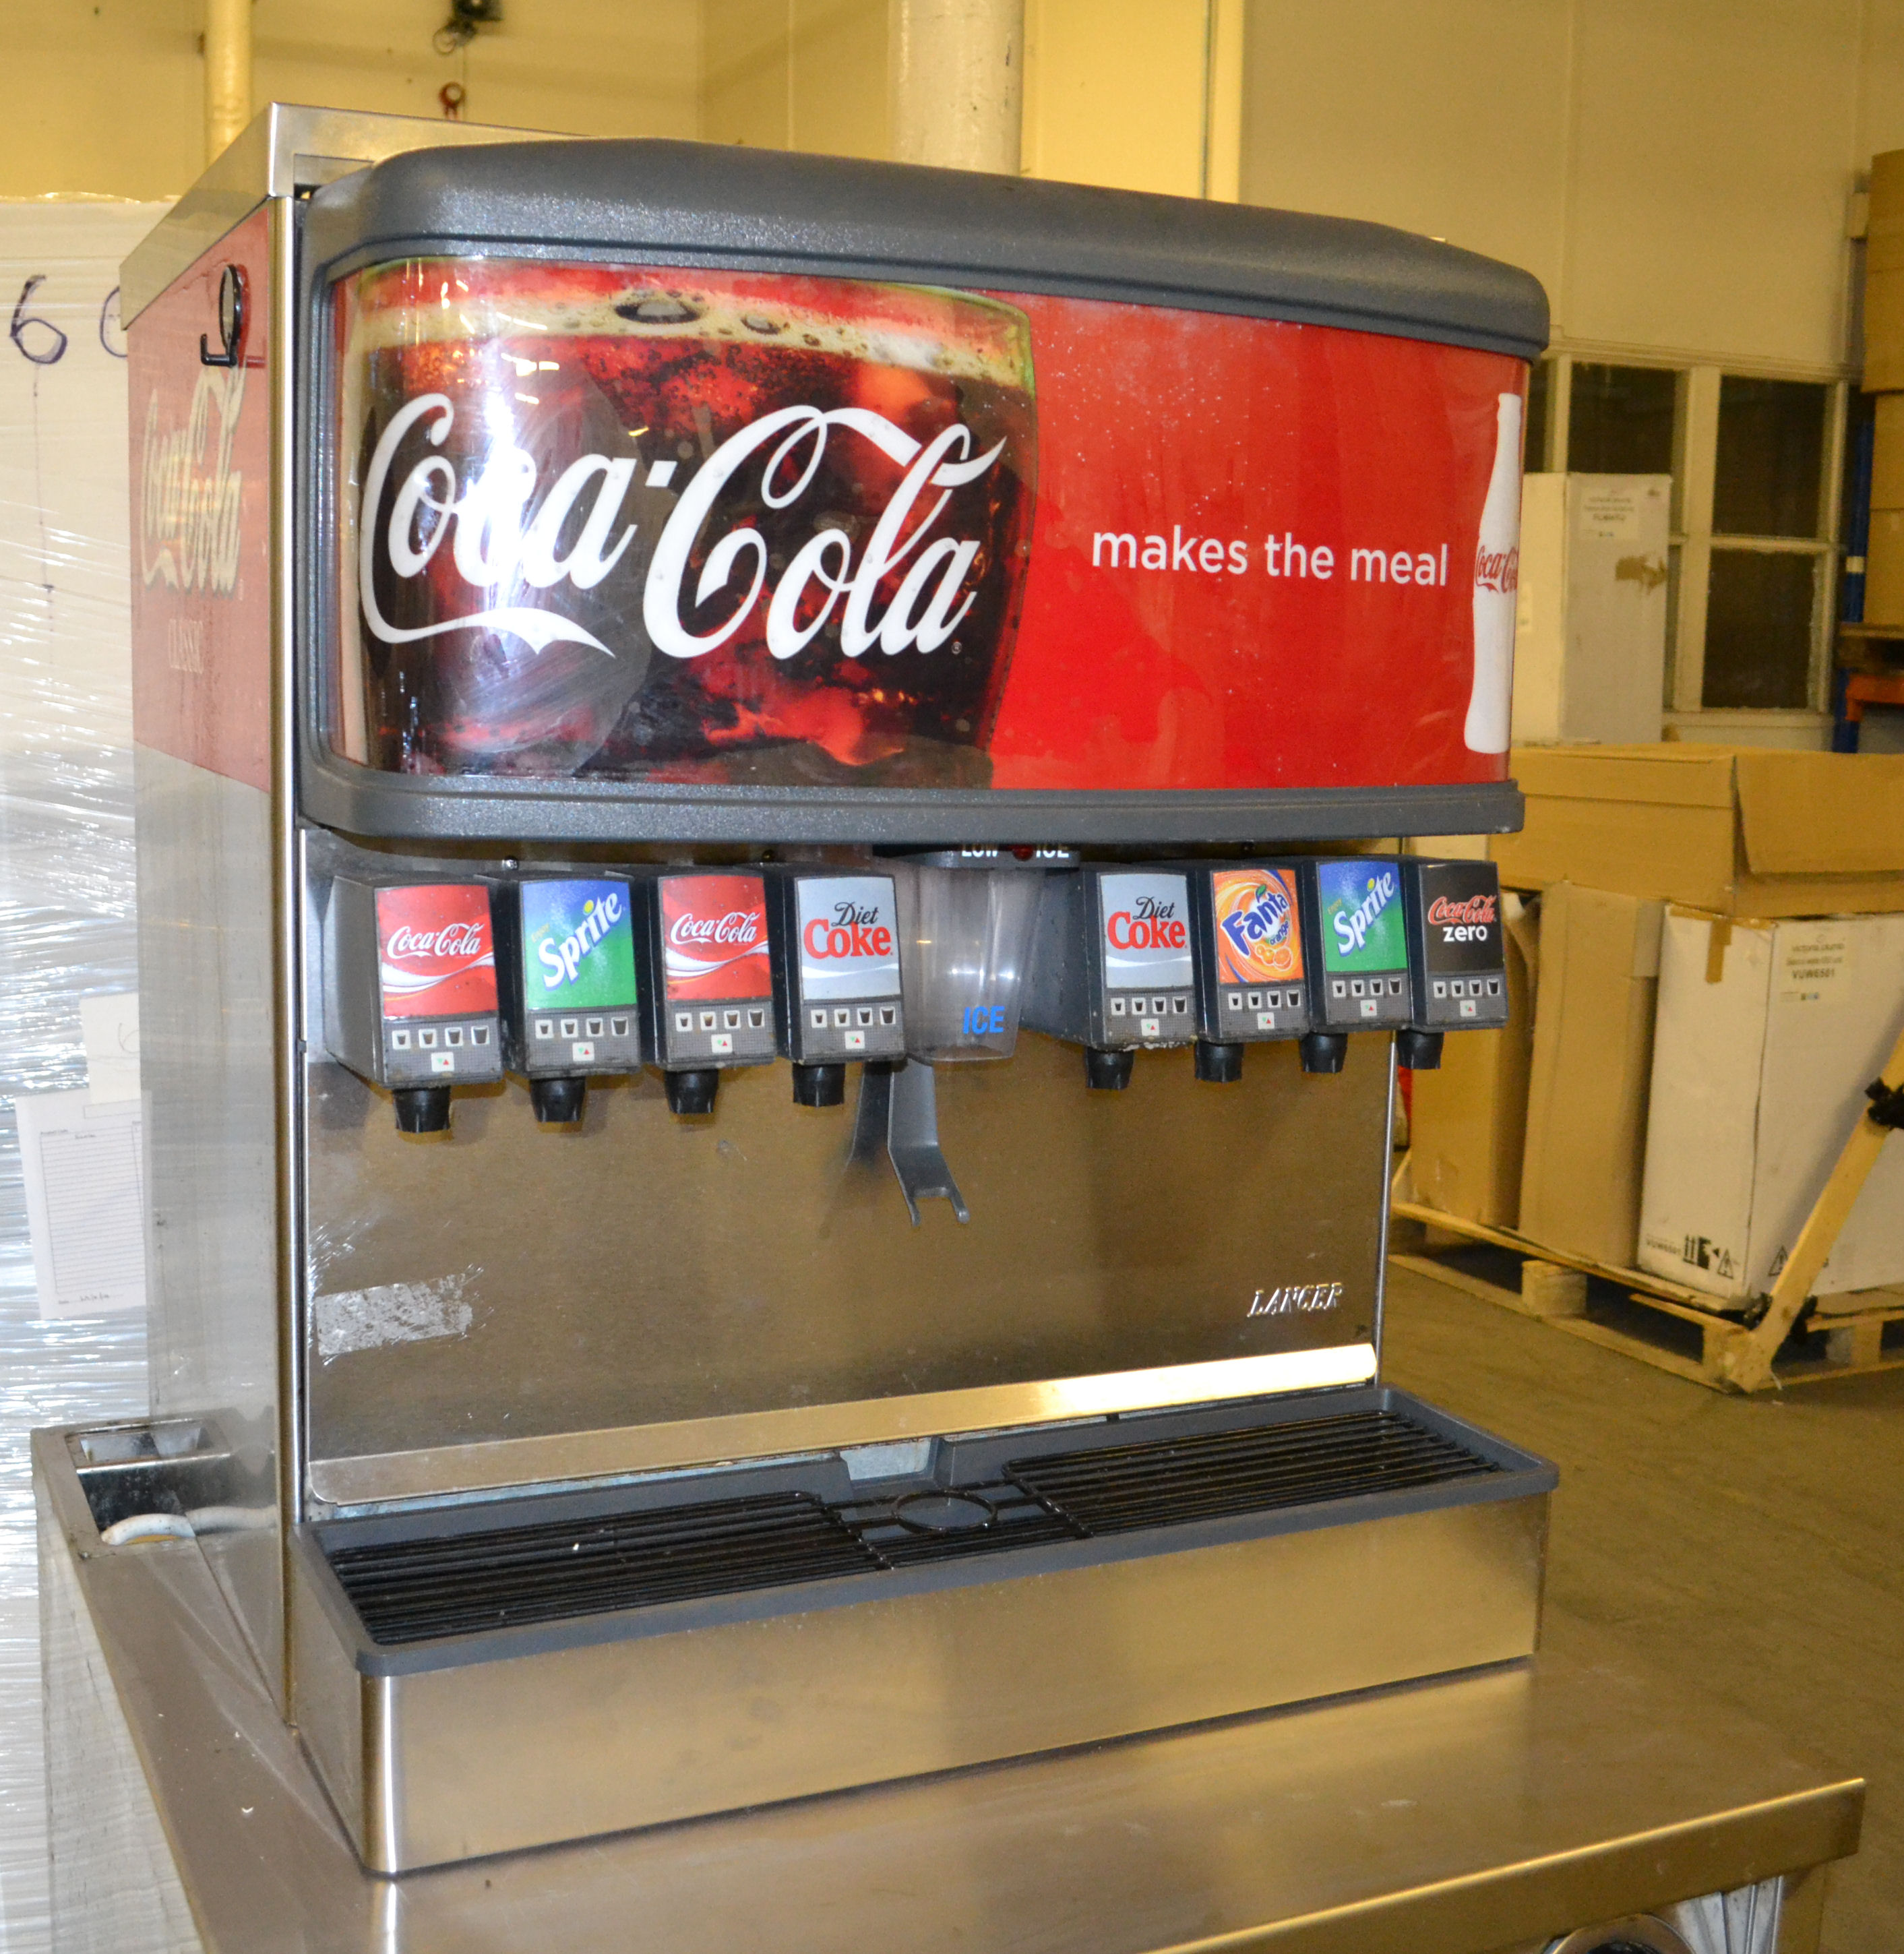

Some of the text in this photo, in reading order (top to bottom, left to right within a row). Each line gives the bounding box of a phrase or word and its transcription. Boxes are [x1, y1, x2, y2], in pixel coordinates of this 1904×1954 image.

[360, 393, 1008, 660] Coca-Cola
[1092, 524, 1448, 586] makes the meal
[831, 901, 880, 927] Diet
[1132, 896, 1175, 920] Diet
[1221, 891, 1290, 958] Fanta
[1333, 872, 1395, 957] Sprite
[1427, 895, 1497, 925] Coca-Cola
[387, 922, 485, 959] Coca-Cola
[538, 892, 623, 991] Sprite
[670, 911, 762, 945] Coca-Cola
[803, 918, 892, 959] Coke
[1107, 911, 1186, 950] Coke
[1269, 920, 1290, 945] orange
[1443, 925, 1487, 942] zero
[962, 1005, 1005, 1035] ICE
[1246, 1282, 1343, 1318] LANCER
